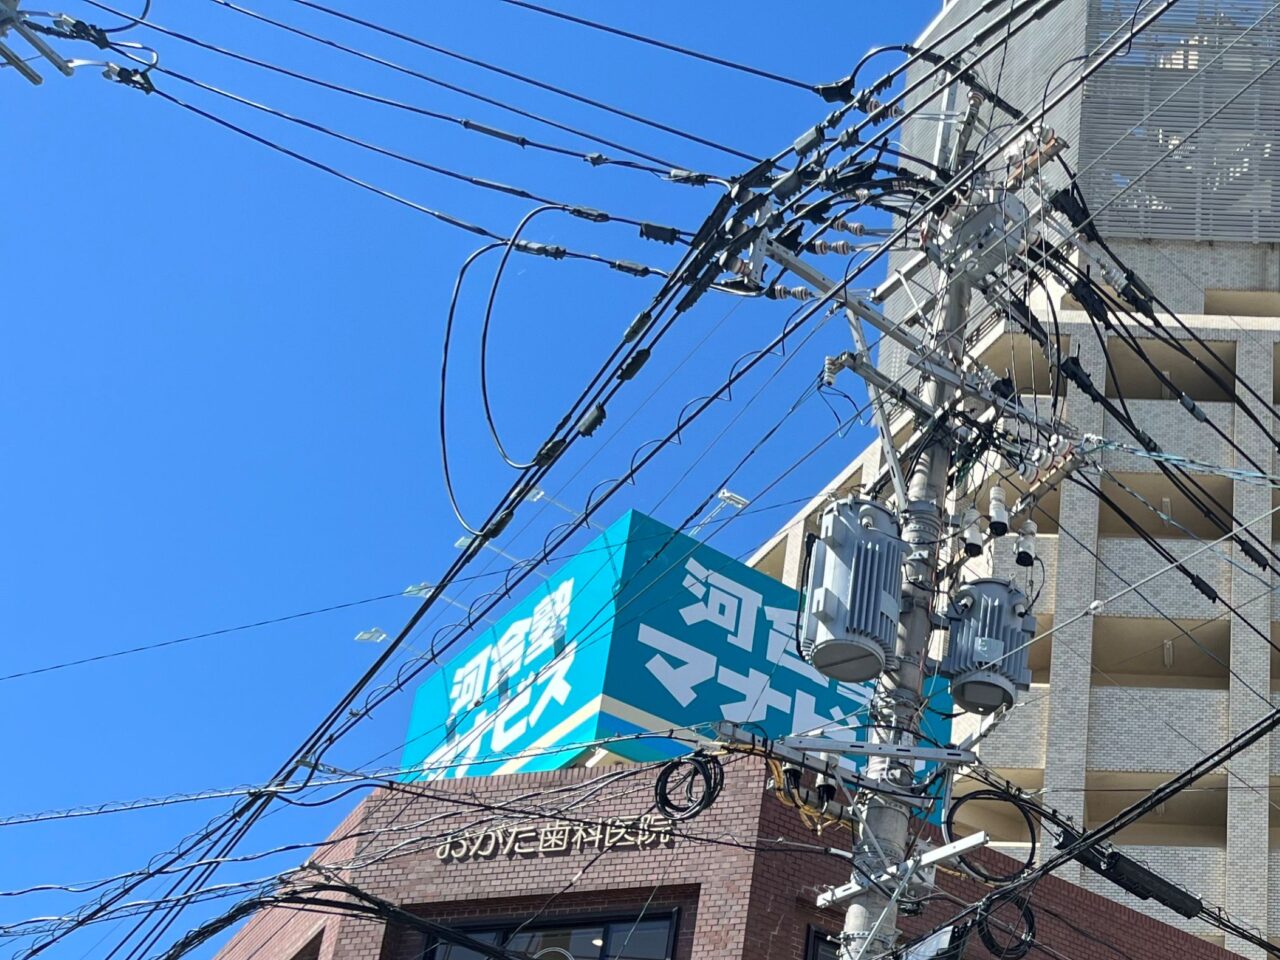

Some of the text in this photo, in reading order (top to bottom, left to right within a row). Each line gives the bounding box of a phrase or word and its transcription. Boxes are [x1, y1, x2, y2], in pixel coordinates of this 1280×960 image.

[436, 814, 672, 859] おがた歯科医院
